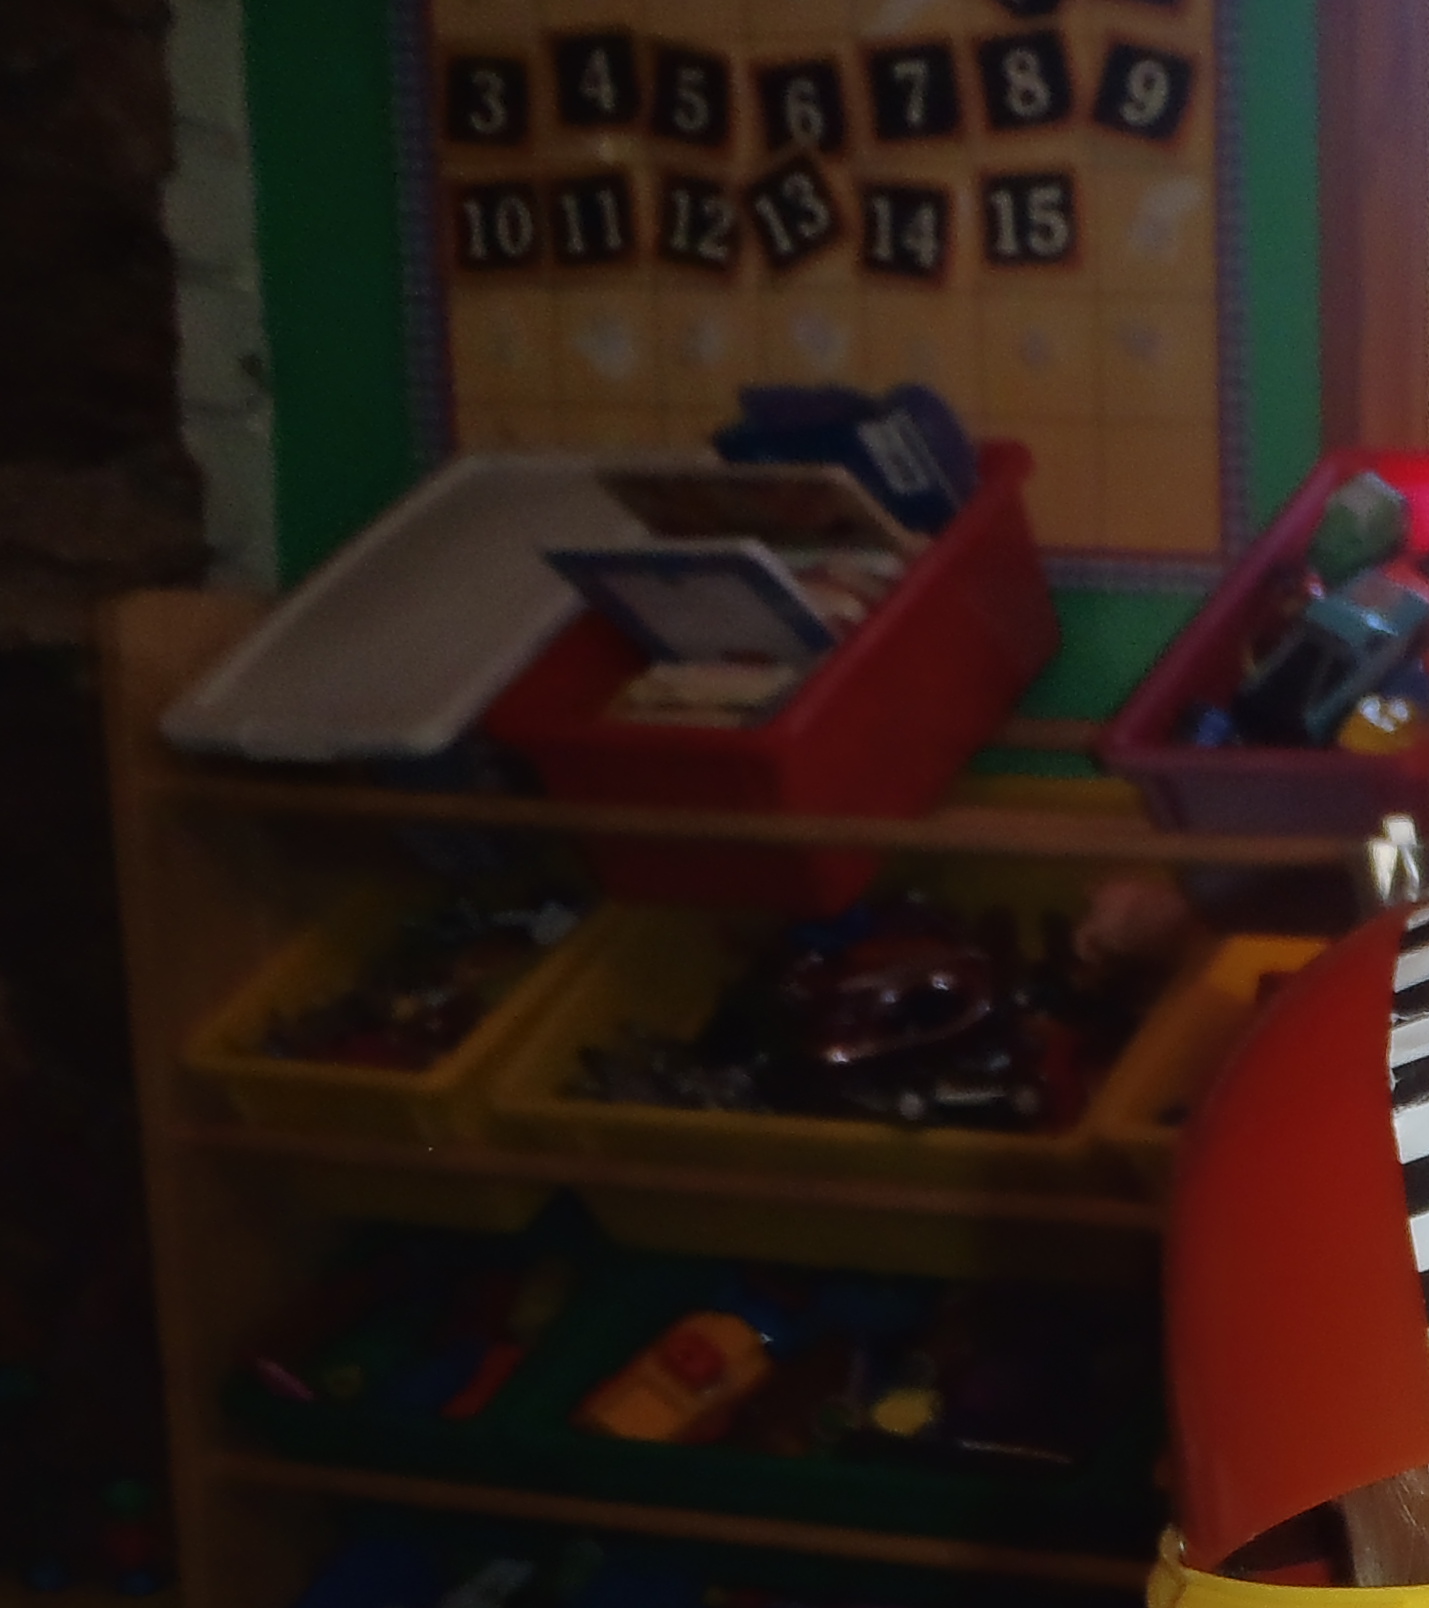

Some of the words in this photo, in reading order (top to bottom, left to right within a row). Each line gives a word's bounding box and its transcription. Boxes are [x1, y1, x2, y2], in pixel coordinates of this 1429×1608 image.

[470, 70, 506, 133] 3
[580, 50, 616, 113] 4
[675, 67, 708, 131] 5
[787, 77, 824, 150] 6
[894, 60, 929, 126] 7
[1003, 48, 1051, 116] 8
[1121, 60, 1167, 125] 9
[464, 200, 534, 260] 10
[562, 189, 622, 254] 11
[671, 190, 737, 261] 12
[755, 173, 830, 254] 13
[871, 196, 939, 268] 14
[991, 186, 1068, 255] 15
